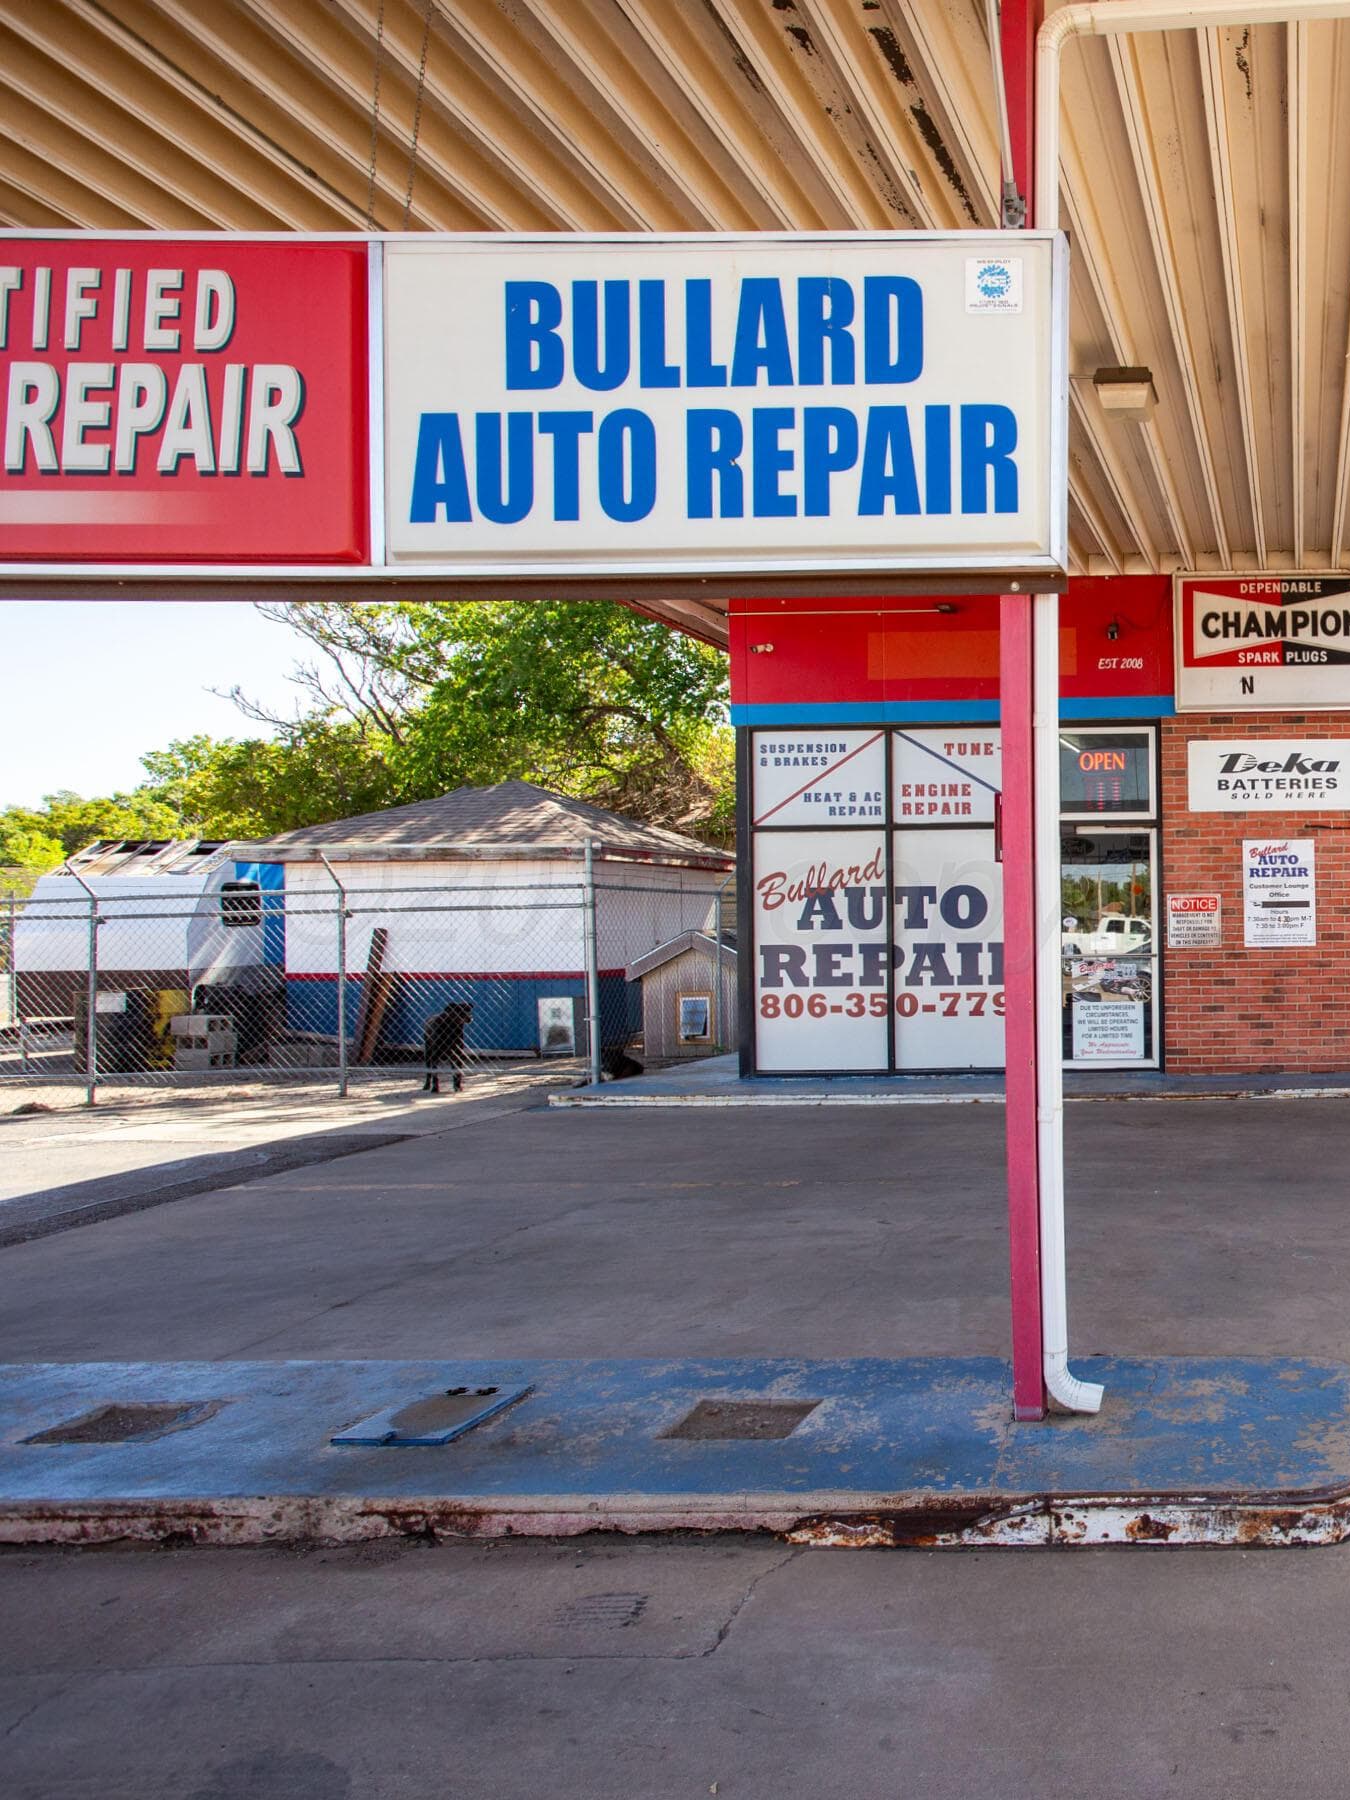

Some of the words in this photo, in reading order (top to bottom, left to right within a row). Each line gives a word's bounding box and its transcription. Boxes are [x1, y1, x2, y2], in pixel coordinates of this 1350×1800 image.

[505, 275, 923, 391] BULLARD
[5, 362, 304, 477] REPAIR
[409, 408, 656, 524] AUTO
[686, 404, 1018, 518] REPAIR
[1240, 581, 1322, 594] DEPENDABLE
[1098, 658, 1118, 669] EST
[1120, 658, 1143, 669] 2008
[1238, 652, 1280, 664] SPARK
[1286, 651, 1328, 663] PLUGS
[1240, 675, 1254, 694] N
[760, 743, 847, 754] SUSPENSION
[760, 757, 768, 766] &
[774, 756, 828, 767] BRAKES
[1078, 751, 1126, 772] OPEN
[1219, 753, 1341, 774] Deka
[901, 783, 972, 797] ENGINE
[1217, 777, 1338, 791] BATTERIES
[804, 792, 843, 803] HEAT
[849, 792, 857, 802] &
[863, 791, 882, 802] AC
[1231, 792, 1273, 800] SOLD
[1285, 791, 1327, 799] HERE
[828, 806, 882, 817] REPAIR
[901, 802, 972, 816] REPAIR
[1249, 842, 1289, 858] Bullard
[1258, 855, 1299, 865] AUTO
[757, 847, 884, 911] Bullard
[1249, 867, 1309, 877] REPAIR
[797, 884, 988, 931] AUTO
[1171, 899, 1217, 910] NOTICE
